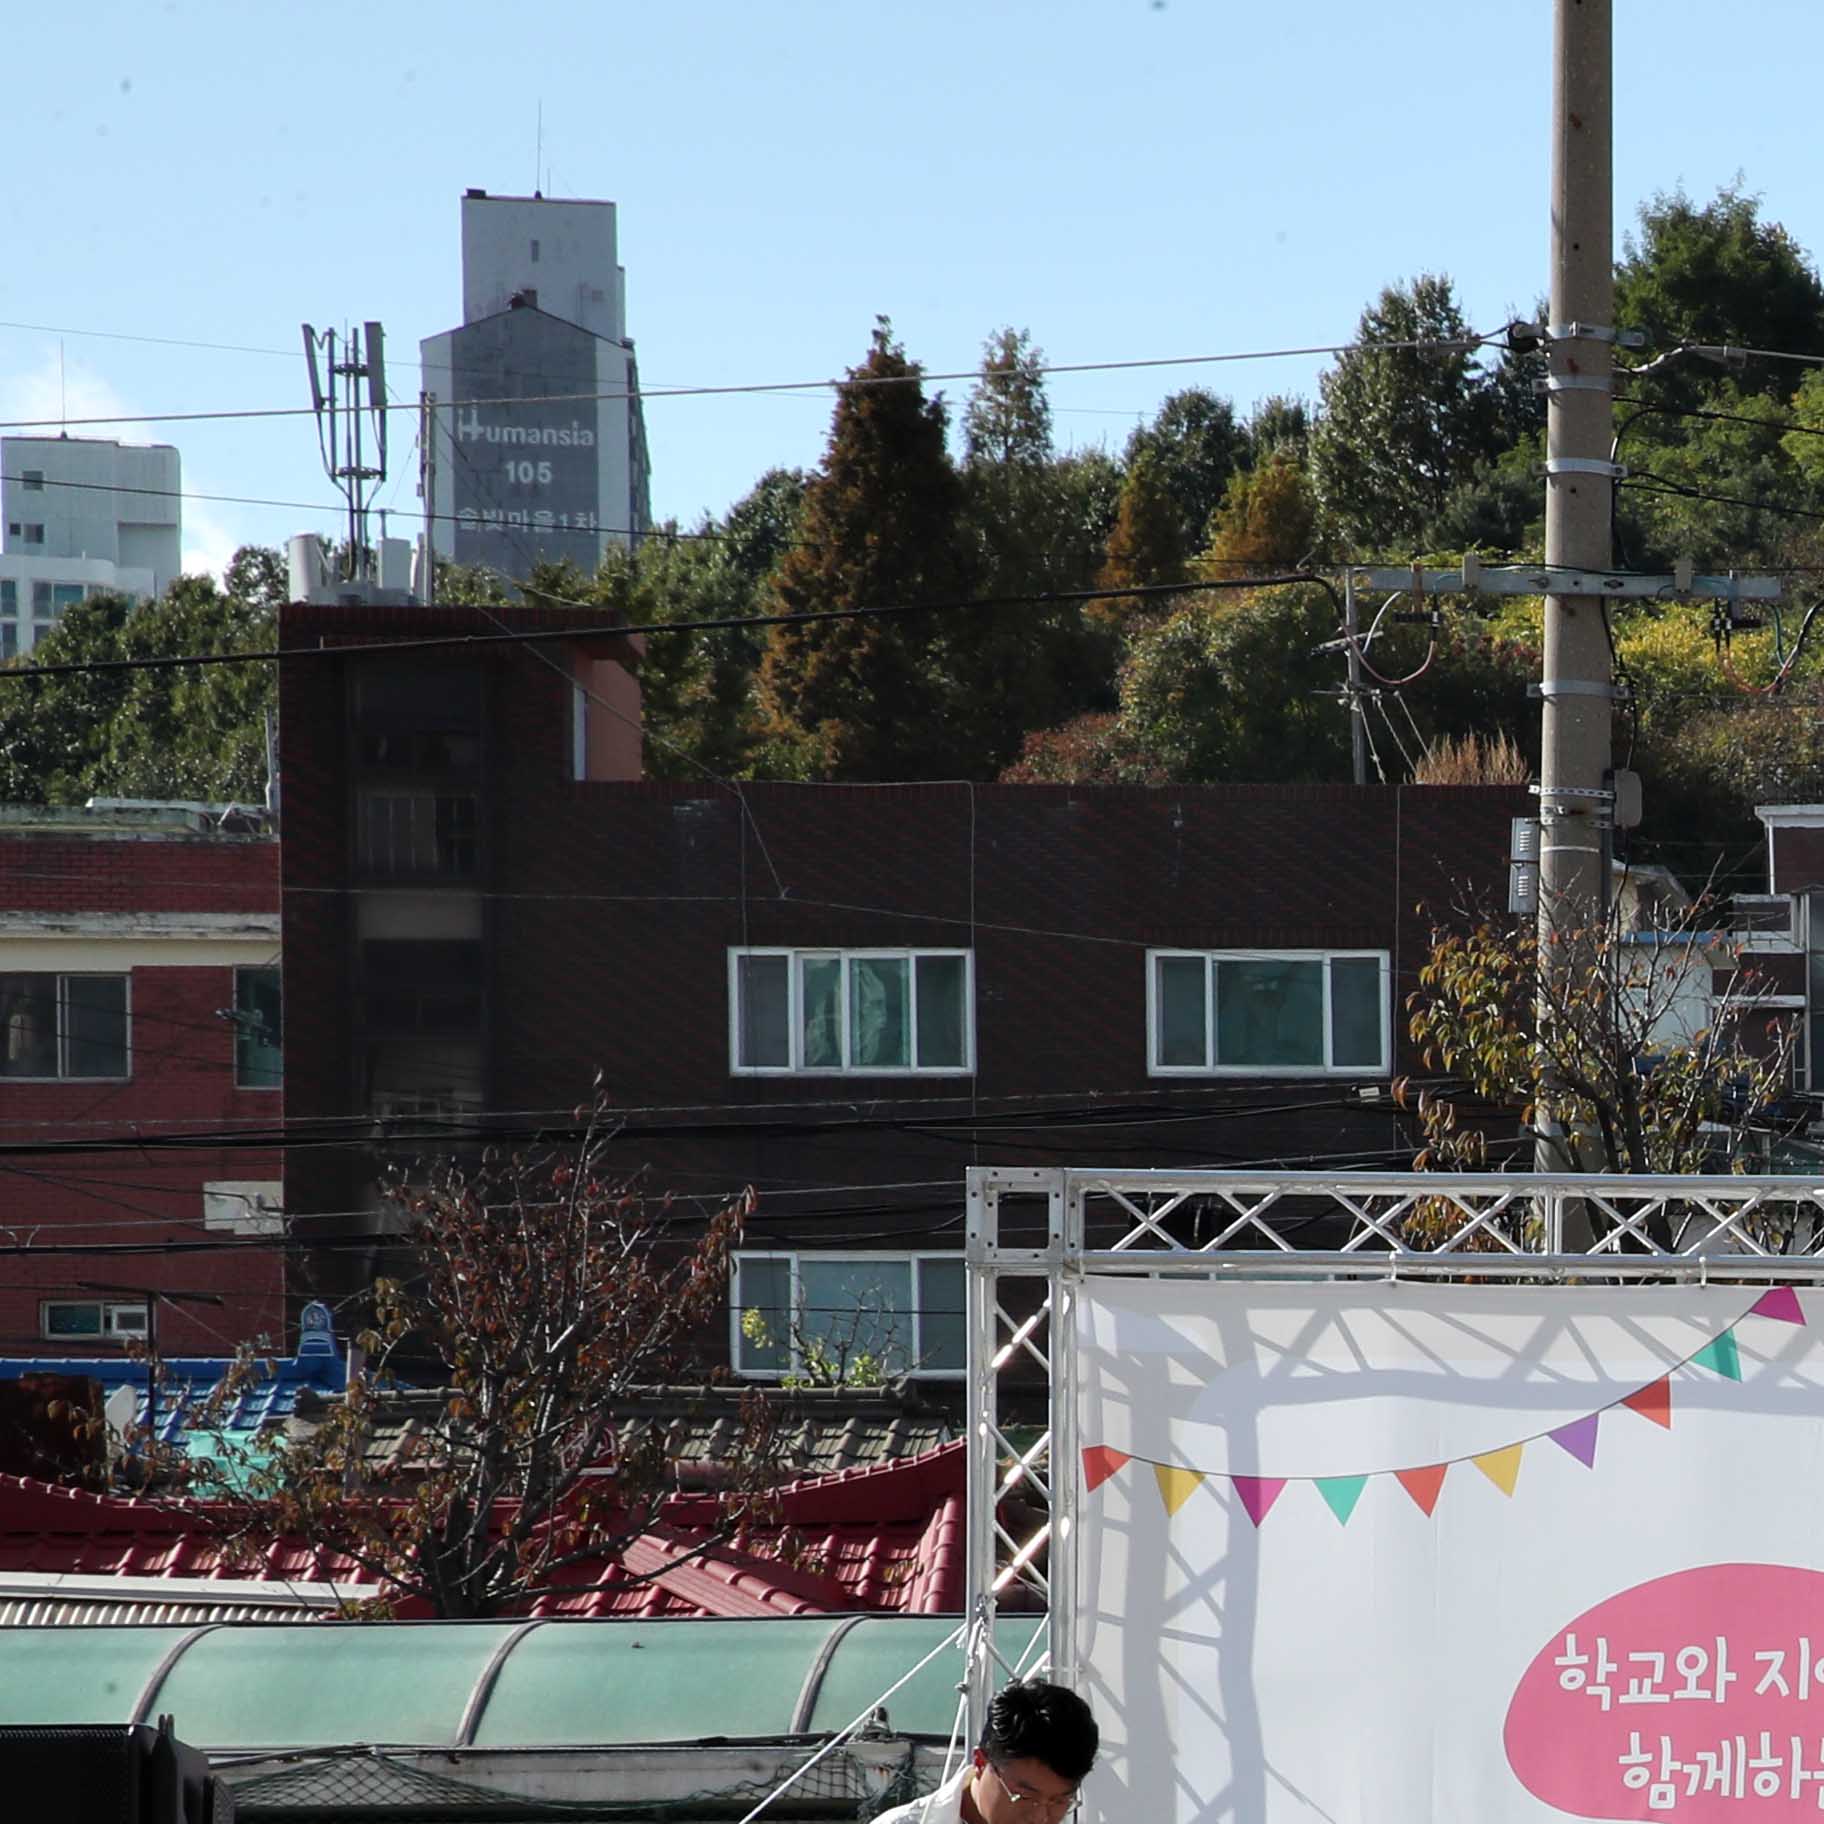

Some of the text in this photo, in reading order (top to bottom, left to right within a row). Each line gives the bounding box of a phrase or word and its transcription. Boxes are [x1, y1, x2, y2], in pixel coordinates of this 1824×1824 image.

[457, 404, 595, 446] Humansia
[504, 460, 553, 485] 105
[1554, 1633, 1736, 1711] 학교와
